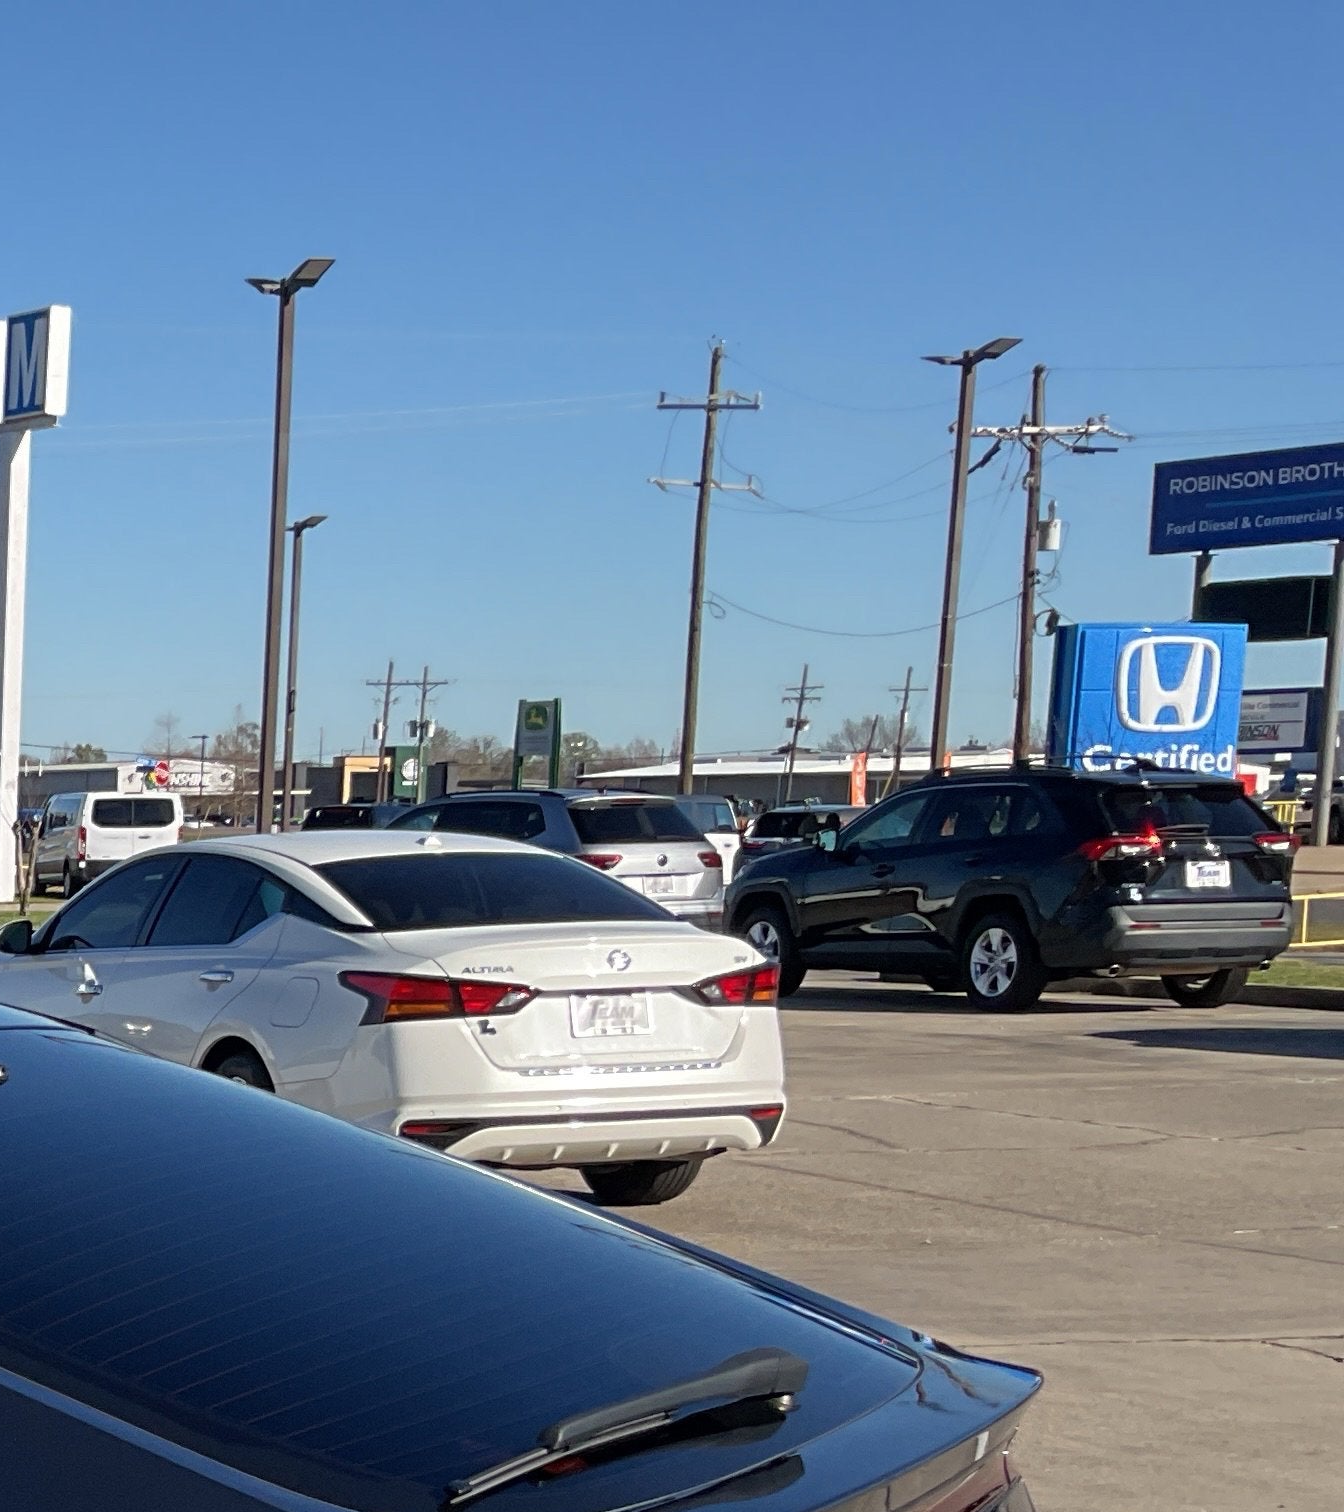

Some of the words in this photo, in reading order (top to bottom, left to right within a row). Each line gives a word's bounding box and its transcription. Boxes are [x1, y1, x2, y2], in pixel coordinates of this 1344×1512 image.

[1169, 469, 1273, 495] ROBINSON
[1278, 462, 1344, 485] BROTH
[1166, 521, 1196, 536] Ford
[1199, 517, 1238, 533] Diesel
[1241, 516, 1252, 529] &
[1255, 506, 1332, 528] Commercial
[462, 965, 515, 975] ALTIMA
[589, 999, 635, 1020] TEAM
